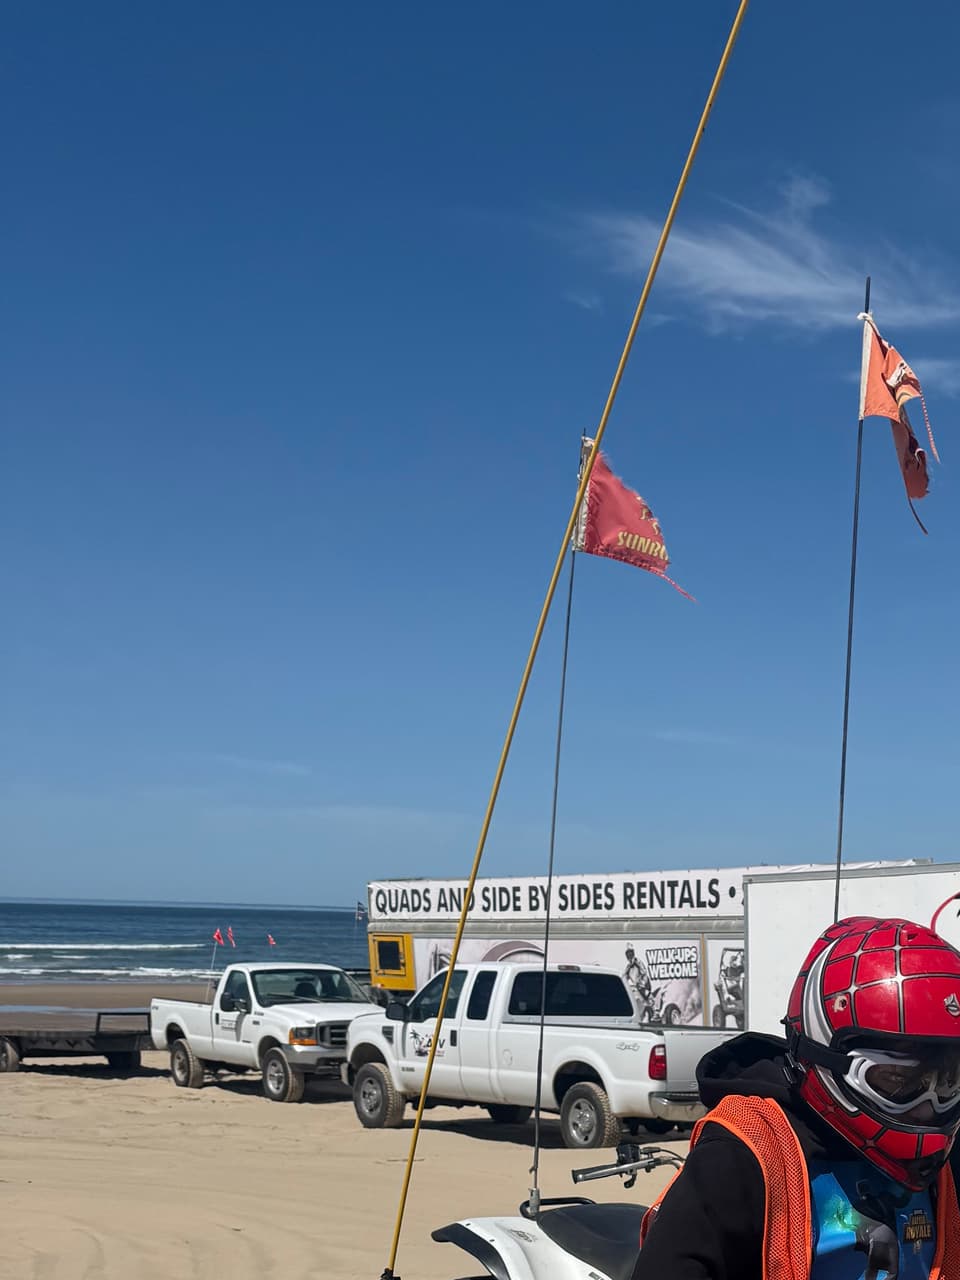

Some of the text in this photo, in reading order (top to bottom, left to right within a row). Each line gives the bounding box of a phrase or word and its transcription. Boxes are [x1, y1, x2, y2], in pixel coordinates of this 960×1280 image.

[375, 887, 432, 915] QUADS
[481, 885, 522, 913] SIDE
[528, 884, 551, 912] BY
[558, 882, 616, 912] SIDES
[623, 878, 721, 911] RENTALS
[646, 946, 697, 965] WALK-UPS
[648, 963, 698, 980] WELCOME
